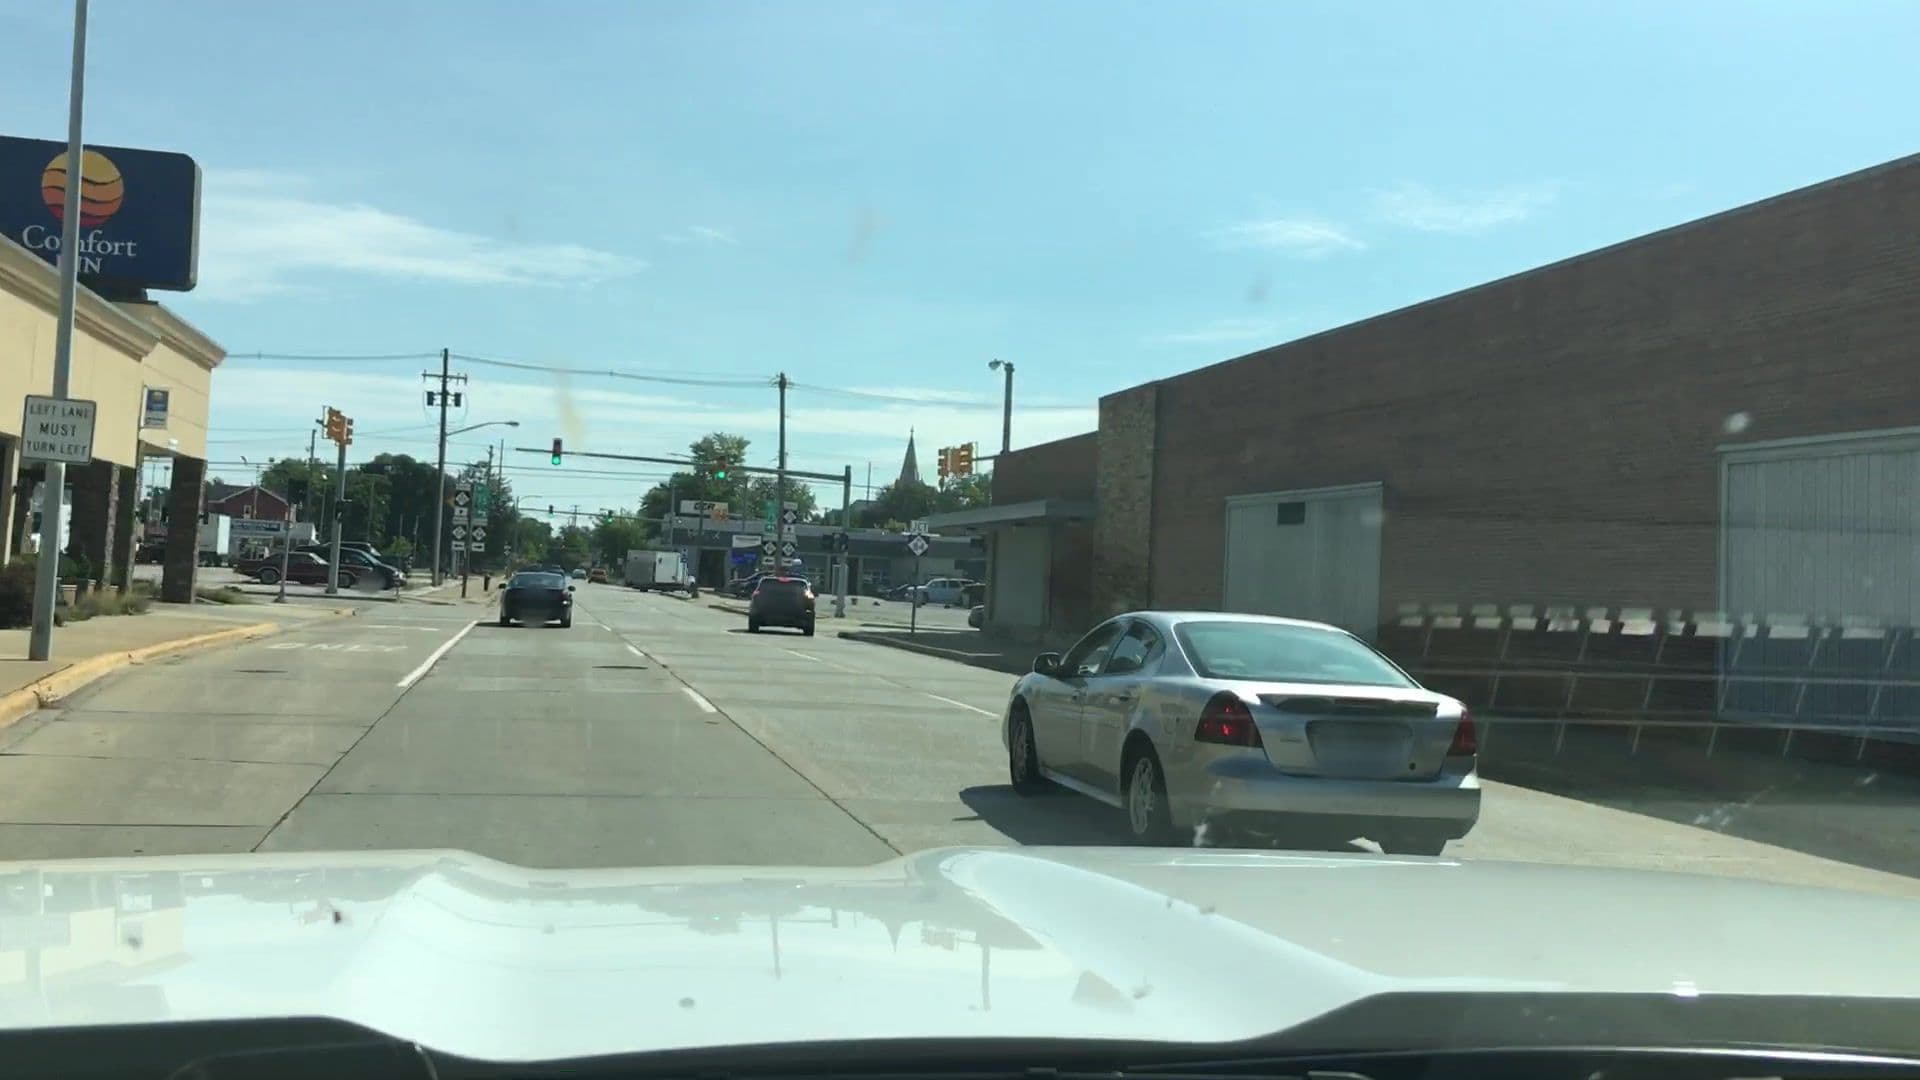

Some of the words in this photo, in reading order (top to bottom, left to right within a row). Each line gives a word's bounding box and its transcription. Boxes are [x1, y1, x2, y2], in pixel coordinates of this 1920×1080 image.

[30, 404, 56, 415] LEFT
[62, 406, 90, 418] LANE
[39, 421, 77, 437] MUST
[26, 439, 56, 453] TURN
[60, 444, 88, 456] LEFT
[266, 642, 409, 652] ONLY
